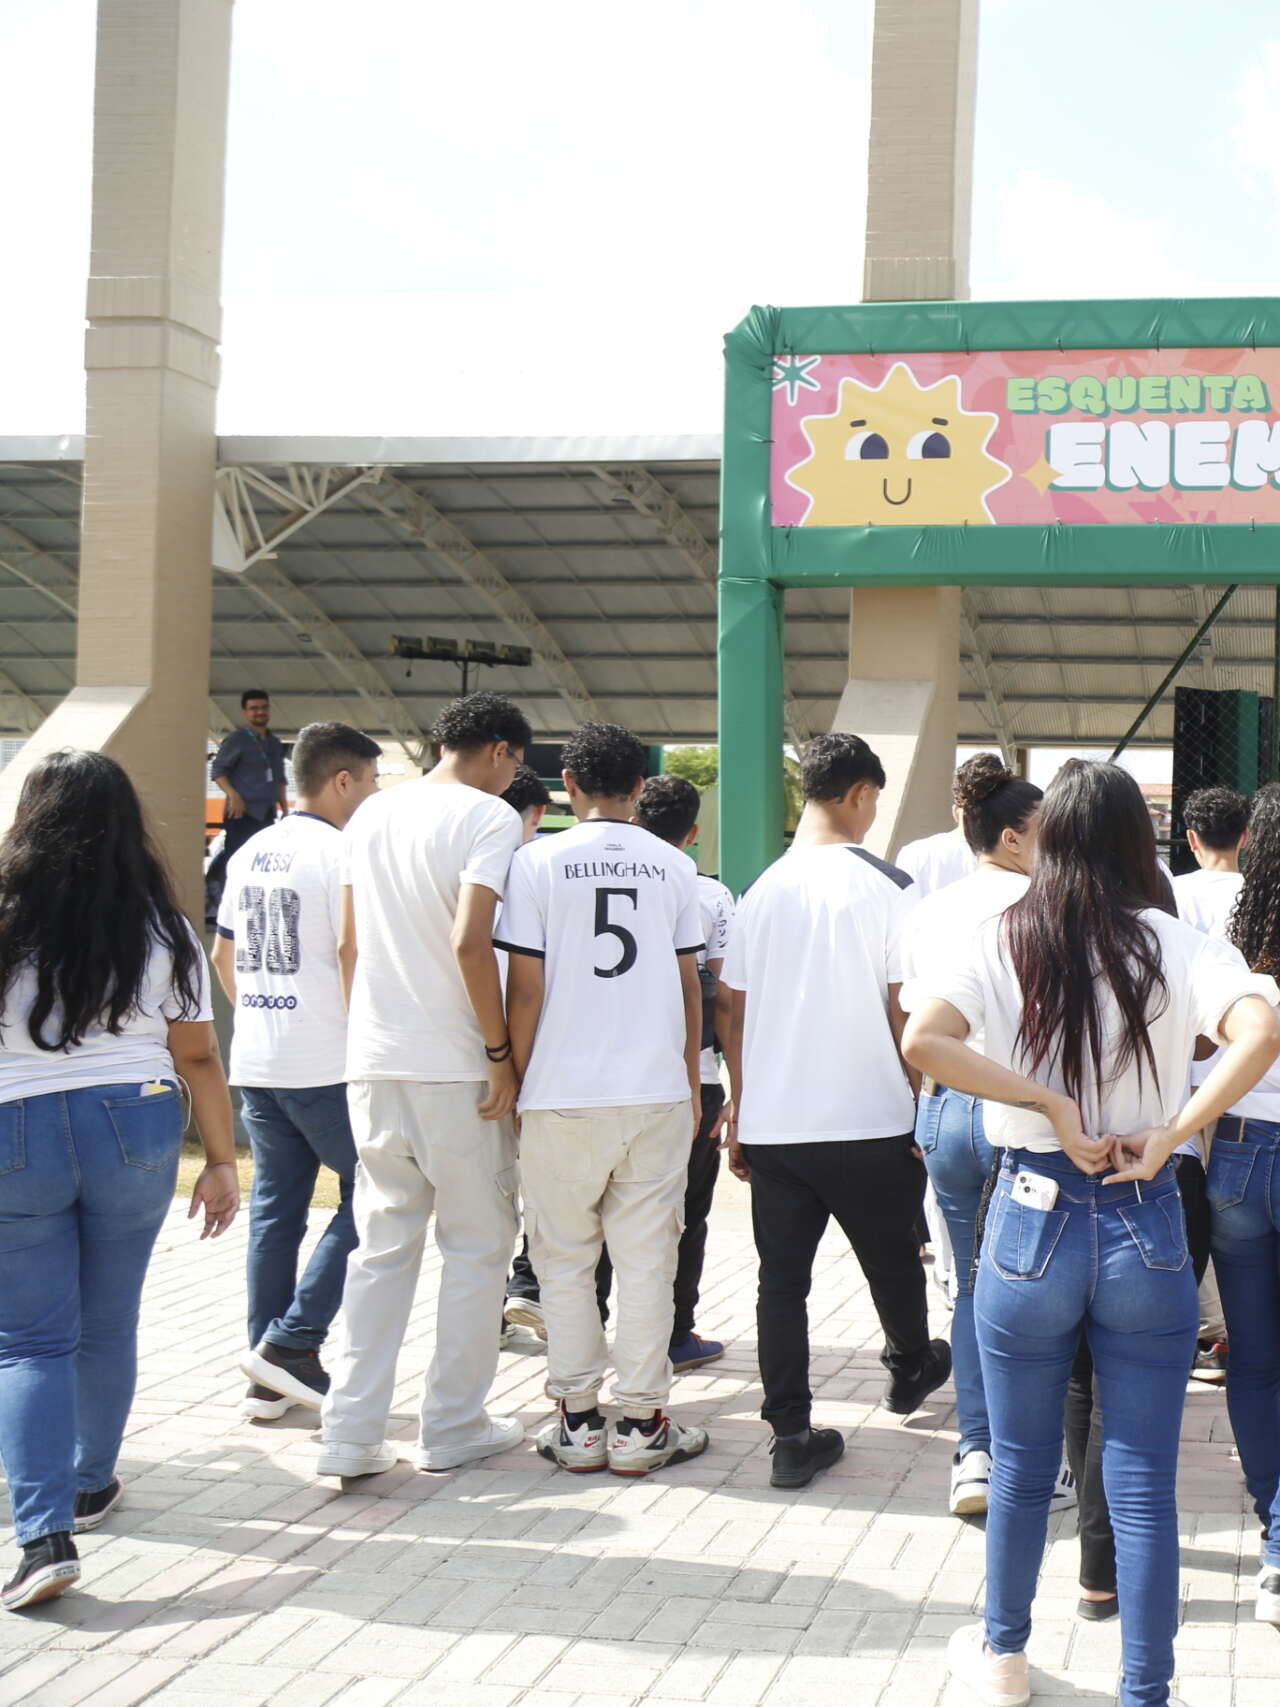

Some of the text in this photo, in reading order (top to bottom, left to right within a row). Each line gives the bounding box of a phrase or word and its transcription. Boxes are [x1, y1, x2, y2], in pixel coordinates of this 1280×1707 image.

[1006, 374, 1271, 418] ESQUENTA
[251, 851, 297, 872] MESSI
[564, 861, 666, 881] BELLINGHAM
[594, 888, 638, 978] 5
